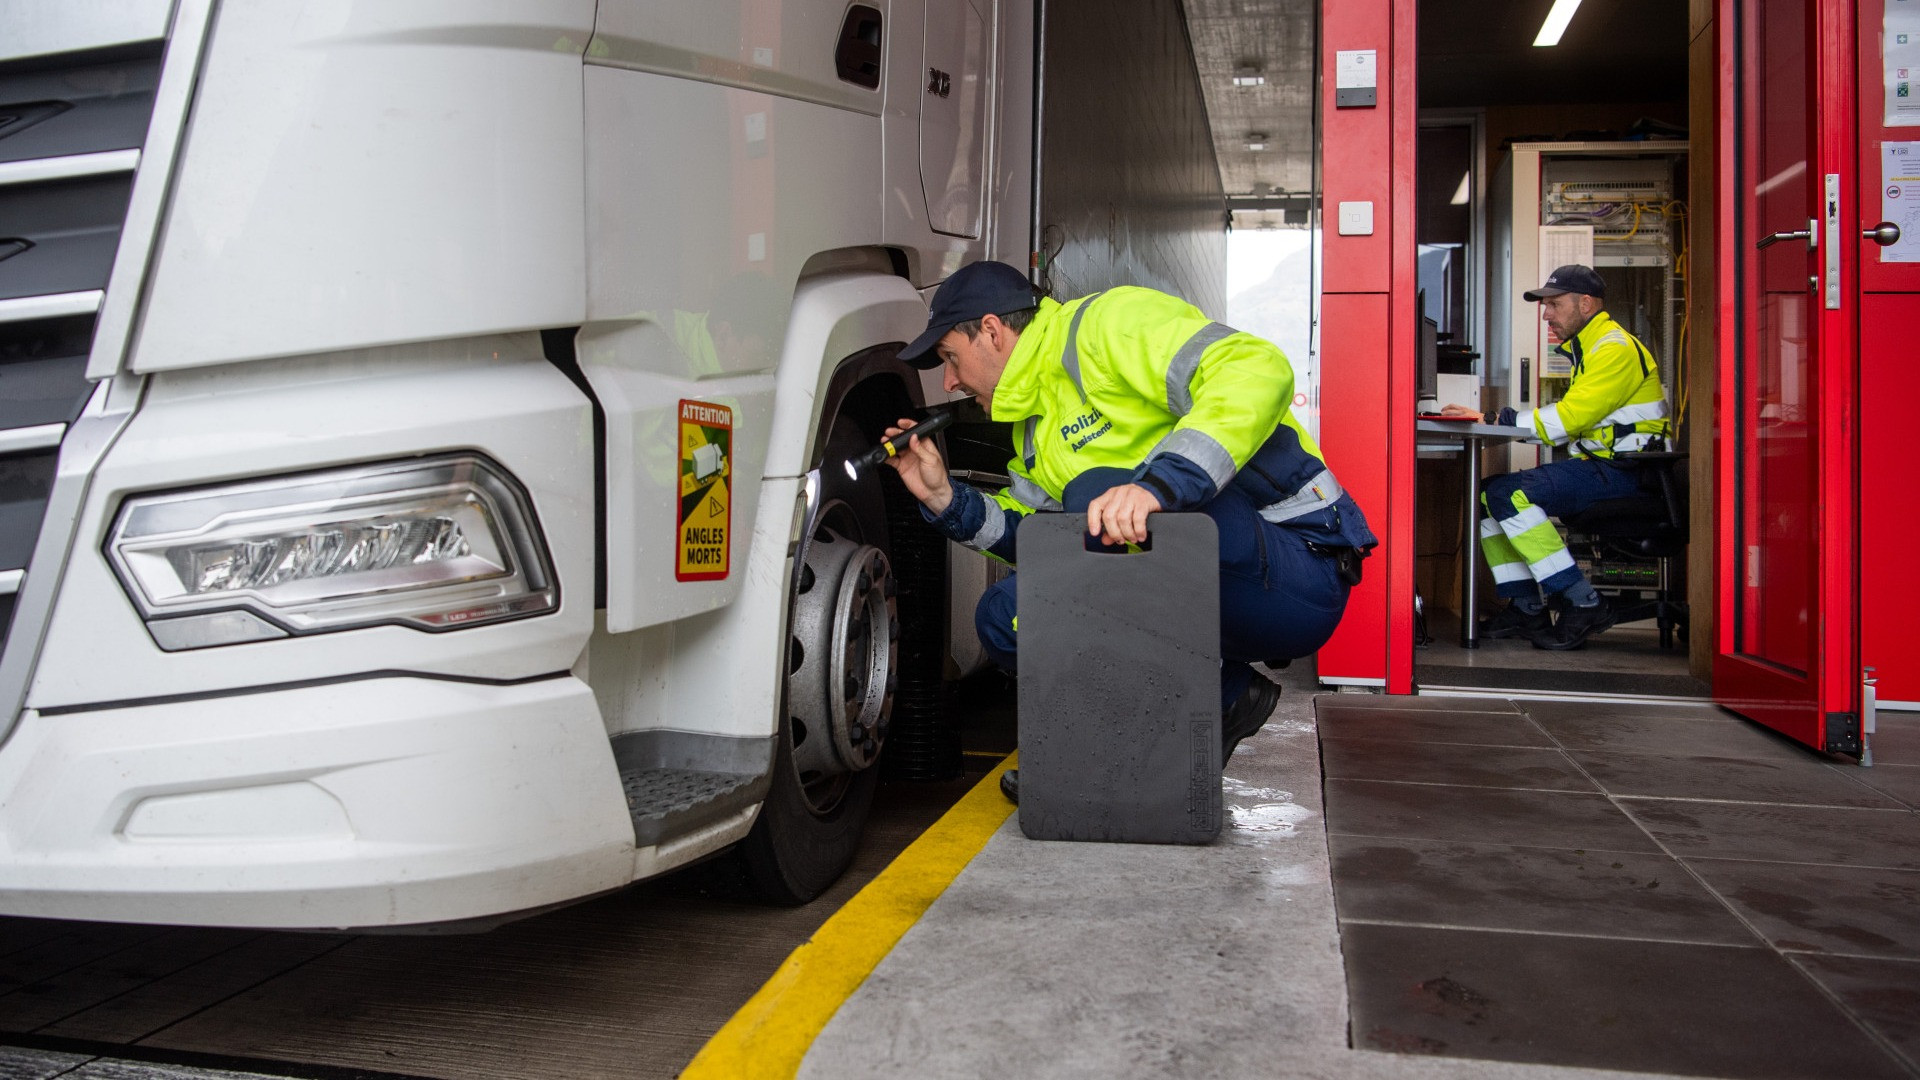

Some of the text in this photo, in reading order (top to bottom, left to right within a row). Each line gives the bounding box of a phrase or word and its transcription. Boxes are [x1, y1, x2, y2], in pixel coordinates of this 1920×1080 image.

[682, 403, 731, 425] ATTENTION
[685, 527, 724, 545] ANGLES
[687, 547, 722, 565] MORTS
[1193, 735, 1209, 830] BERNER
